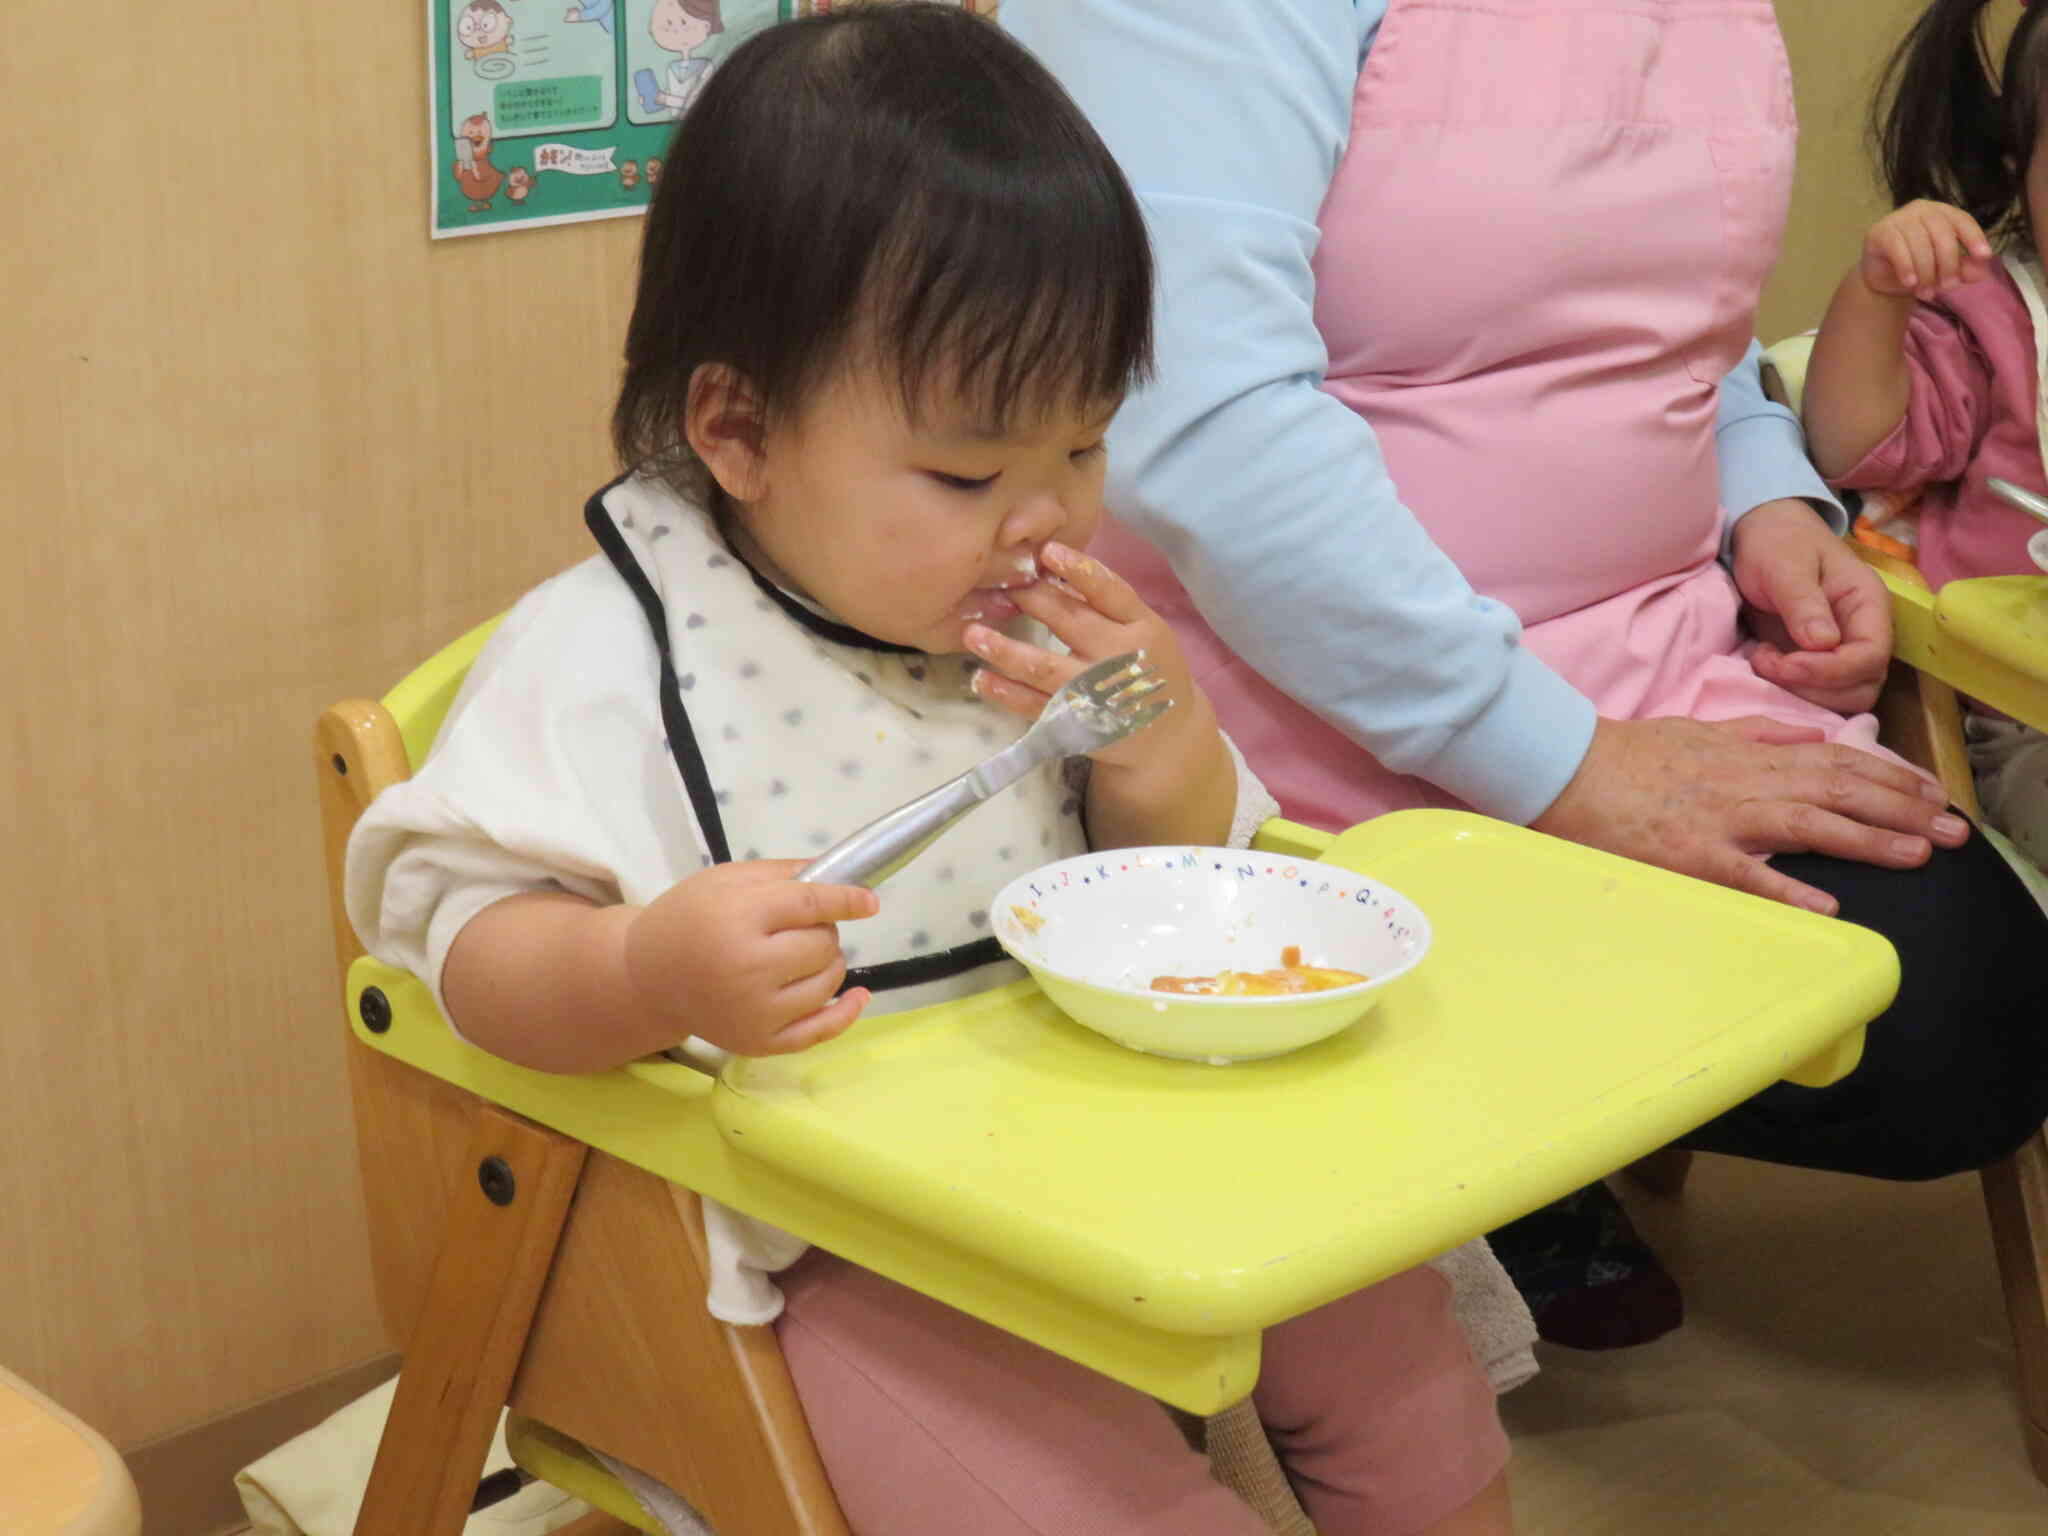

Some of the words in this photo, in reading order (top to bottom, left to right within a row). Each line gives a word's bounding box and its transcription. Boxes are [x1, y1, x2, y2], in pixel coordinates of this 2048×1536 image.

[1096, 864, 1111, 880] K
[1182, 854, 1200, 869] M
[1237, 864, 1255, 881] N
[1355, 888, 1371, 904] Q
